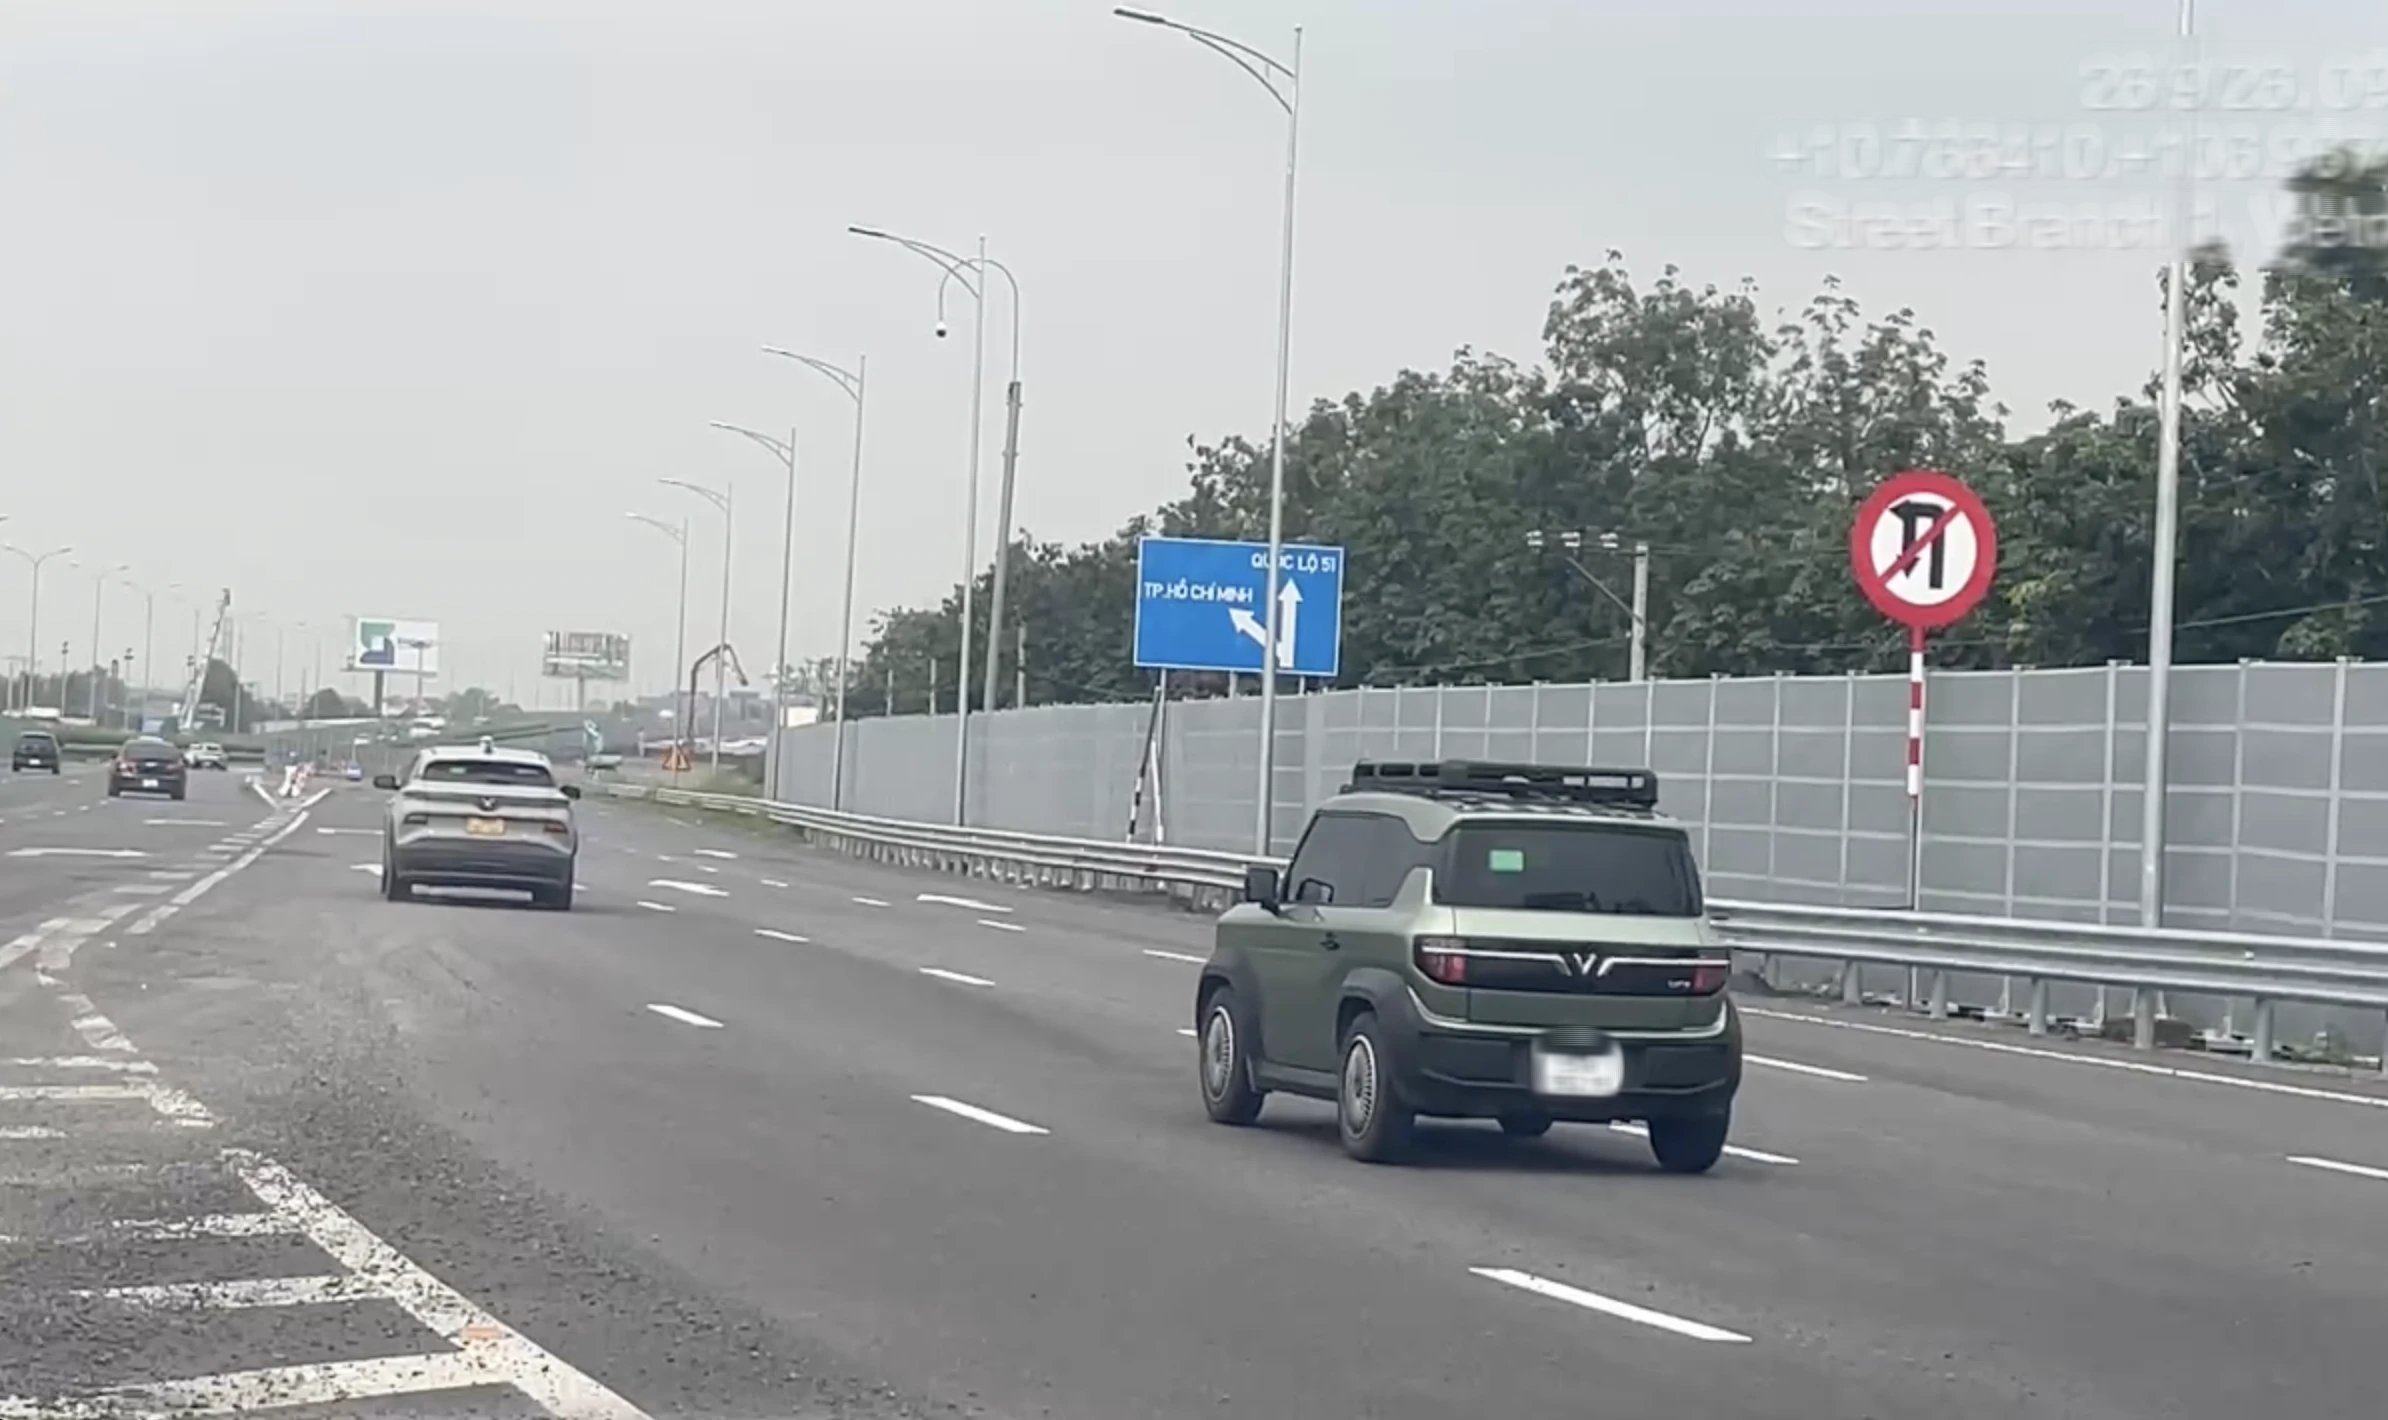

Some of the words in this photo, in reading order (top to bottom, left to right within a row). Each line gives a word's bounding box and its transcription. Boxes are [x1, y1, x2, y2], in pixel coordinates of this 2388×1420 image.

[1297, 552, 1319, 575] LỘ
[1321, 556, 1337, 574] 51
[1190, 581, 1216, 602] CHÍ
[1216, 585, 1253, 604] MINH
